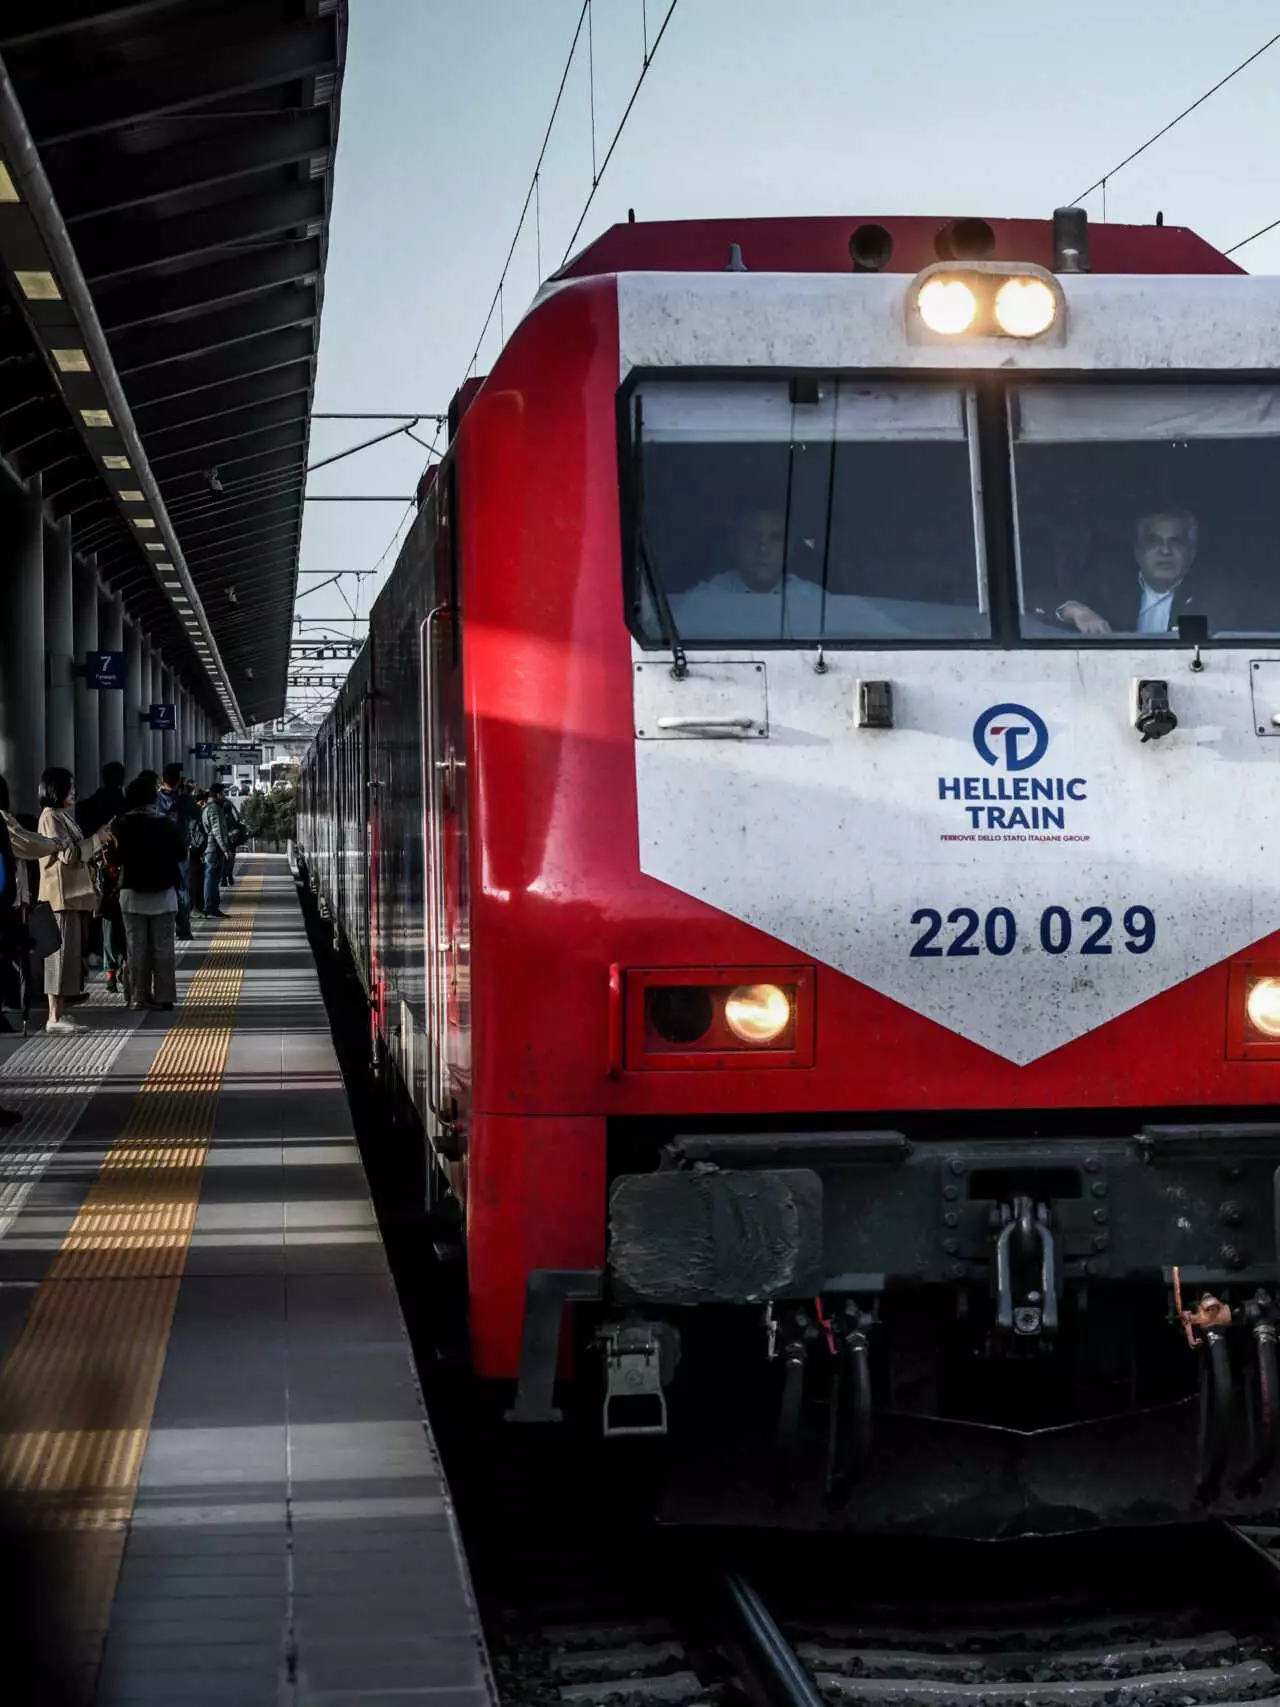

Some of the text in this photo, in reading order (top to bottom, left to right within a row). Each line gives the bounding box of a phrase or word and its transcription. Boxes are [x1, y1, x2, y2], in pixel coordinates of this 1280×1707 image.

[100, 655, 111, 671] 7
[938, 777, 1087, 801] HELLENIC
[965, 806, 1065, 829] TRAIN
[978, 834, 1001, 842] DELLO
[1003, 834, 1026, 842] STATO
[1063, 834, 1090, 842] GROUP
[909, 905, 1156, 957] 220 029
